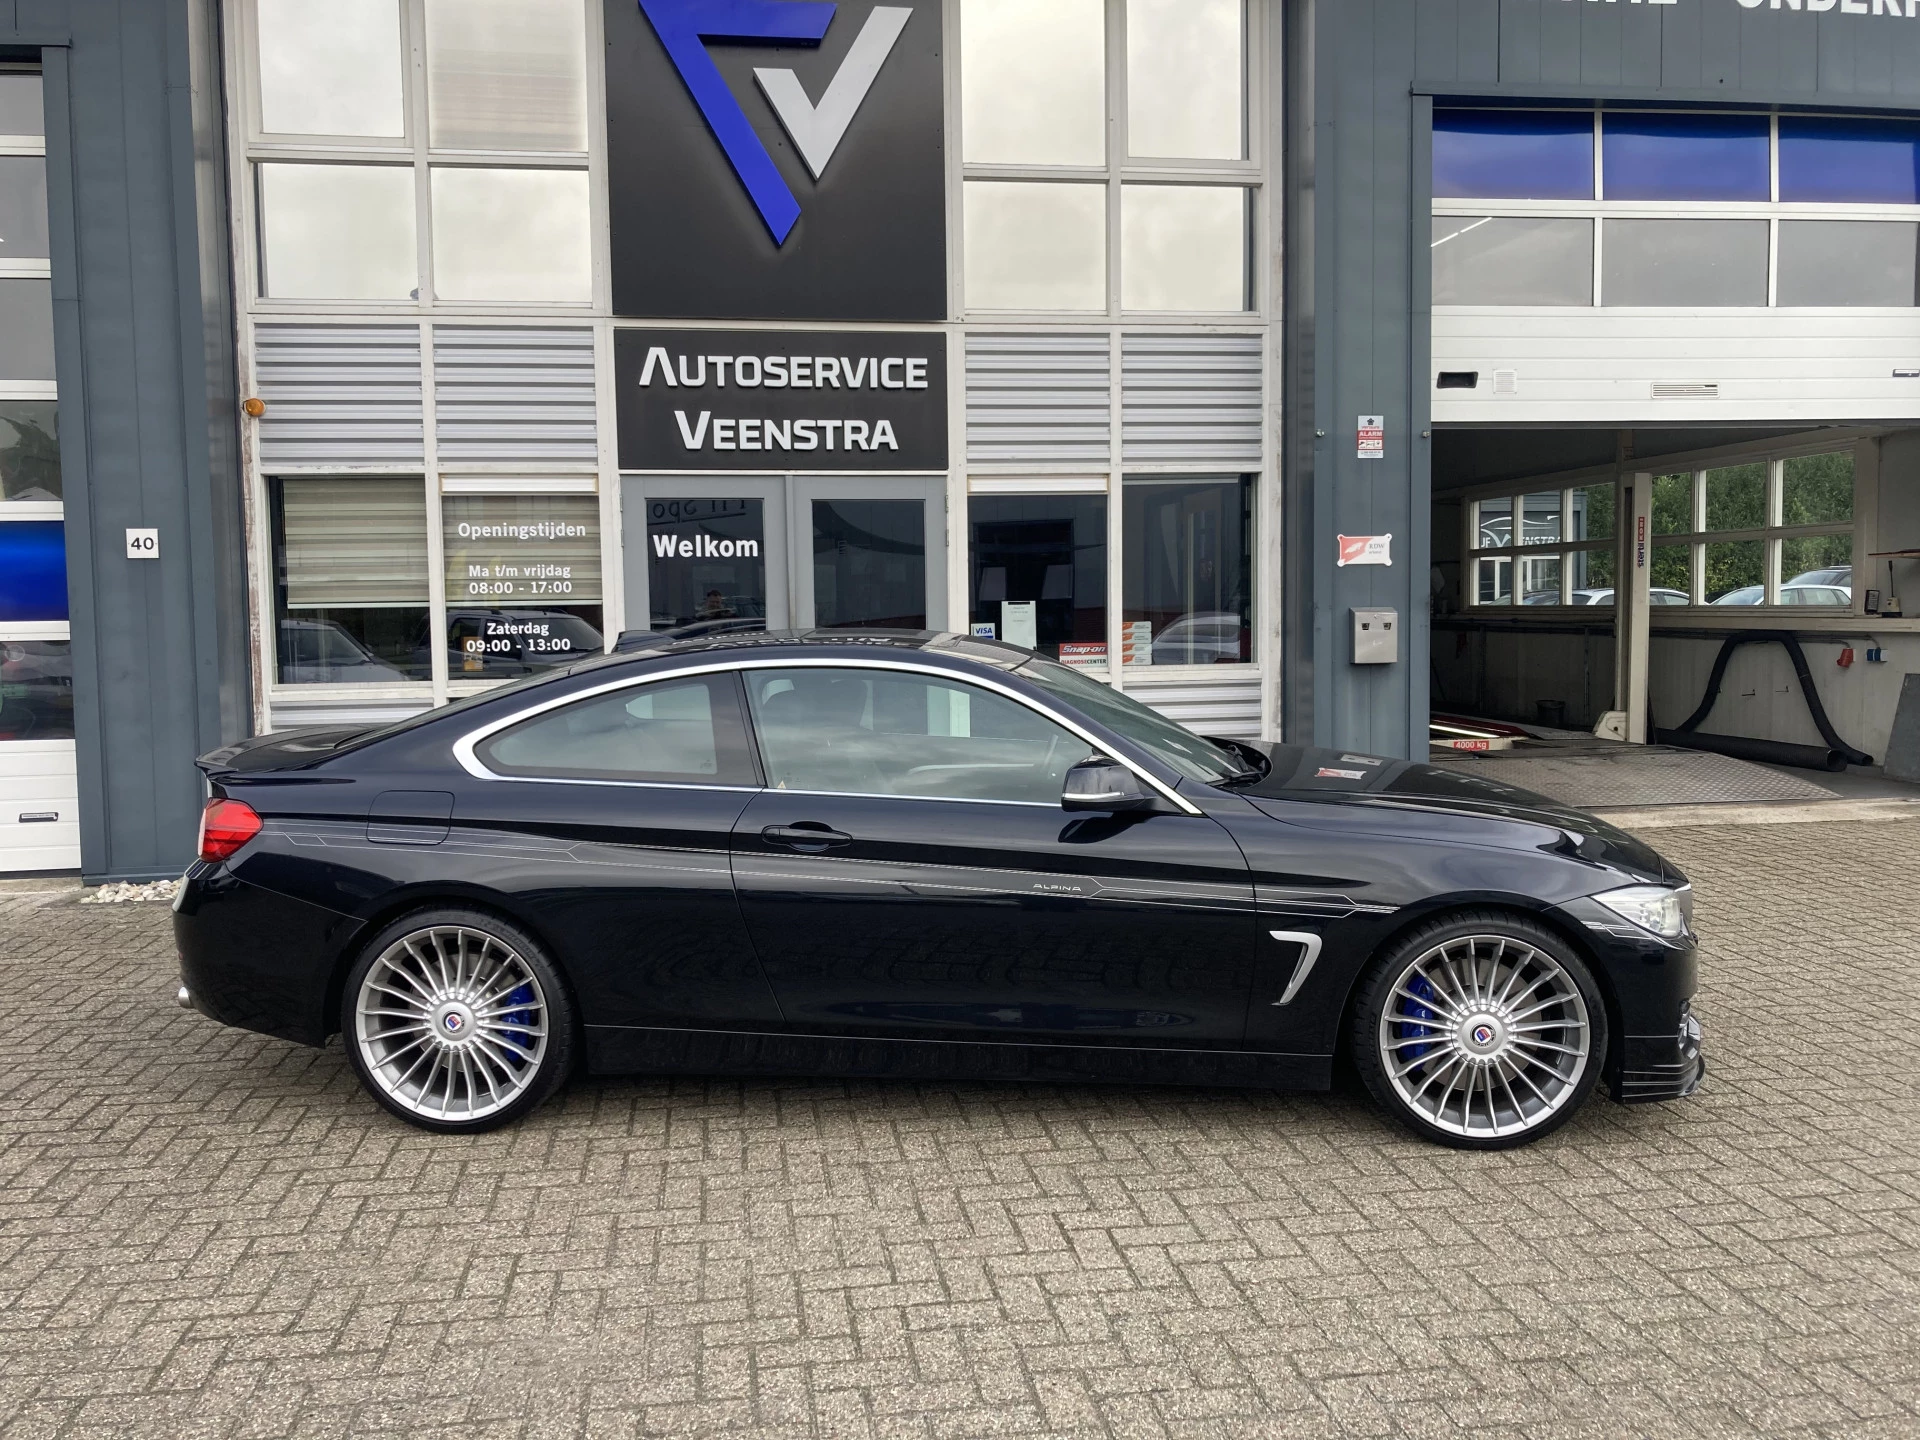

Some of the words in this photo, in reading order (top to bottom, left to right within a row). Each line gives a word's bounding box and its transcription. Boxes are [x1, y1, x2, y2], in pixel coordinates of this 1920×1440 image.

[638, 346, 929, 389] AUTOSERVICE
[673, 410, 899, 451] VEENSTRA
[458, 522, 586, 540] Openingstijden
[130, 536, 154, 550] 40
[652, 534, 759, 558] Welkom
[468, 565, 489, 577] Ma
[494, 565, 518, 577] t/m
[523, 564, 572, 579] vrijdag
[469, 582, 513, 594] 08:00
[530, 581, 572, 594] 17:00
[486, 622, 550, 637] Zaterdag
[975, 627, 993, 635] VISA
[466, 639, 511, 652] 09:00
[528, 638, 571, 651] 13:00
[1062, 645, 1106, 654] Snap-on
[1456, 741, 1475, 749] 4000
[1476, 741, 1487, 750] kg
[1032, 883, 1082, 892] ALPINA
